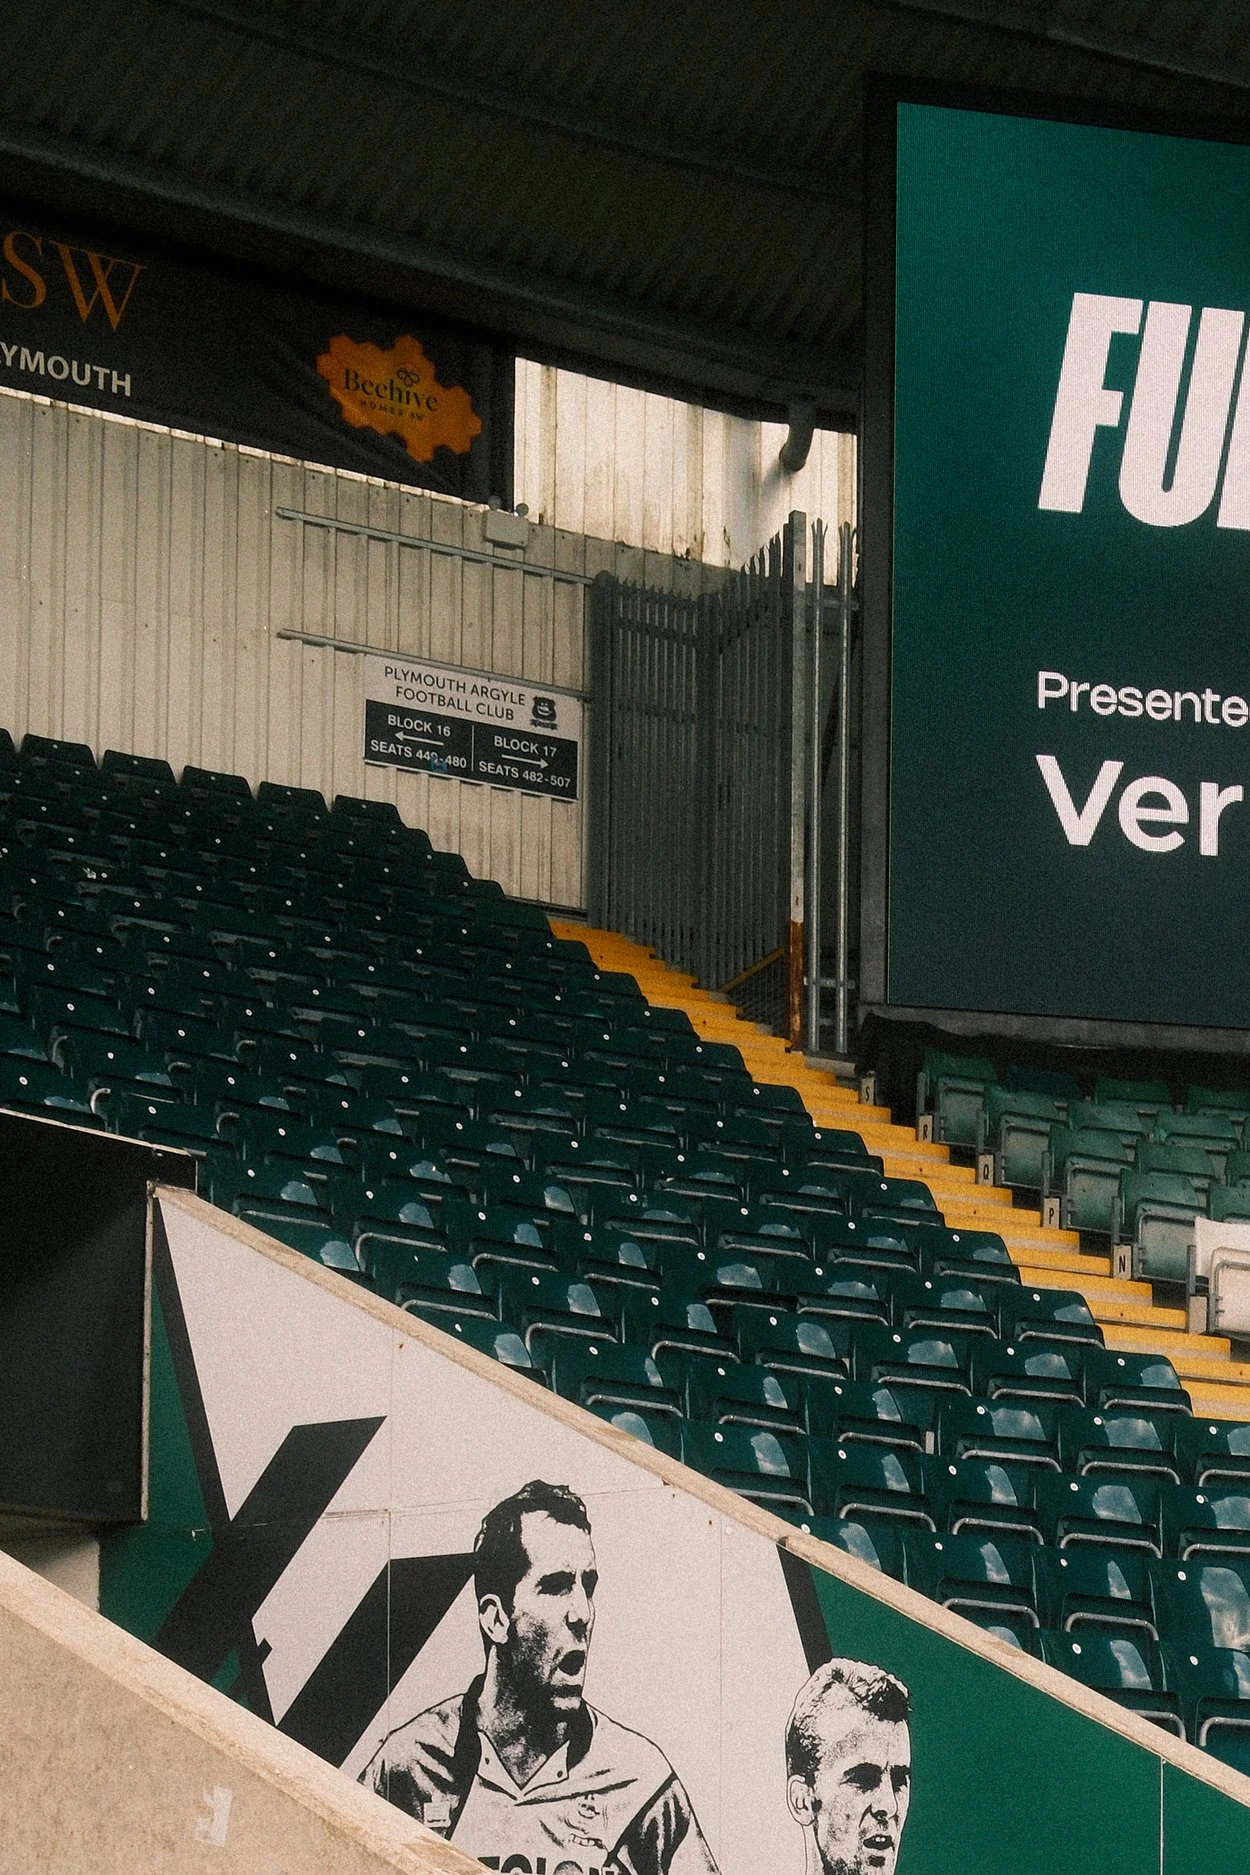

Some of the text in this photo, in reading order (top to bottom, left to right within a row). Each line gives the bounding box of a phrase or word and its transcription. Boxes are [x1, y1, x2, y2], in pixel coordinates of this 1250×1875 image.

[2, 230, 148, 331] SW
[0, 341, 132, 397] YMOUTH
[344, 368, 438, 412] Beehive
[384, 665, 526, 706] PLYMOUTH ARGYLE
[395, 685, 515, 721] FOOTBALL CLUB
[387, 714, 451, 737] BLOCK 16
[370, 740, 413, 758] SEATS
[493, 735, 557, 758] BLOCK 17
[478, 760, 571, 789] SEATS 482-507
[923, 1124, 929, 1137] R
[983, 1163, 989, 1180] Q
[1049, 1207, 1055, 1225] P
[1119, 1255, 1126, 1273] N
